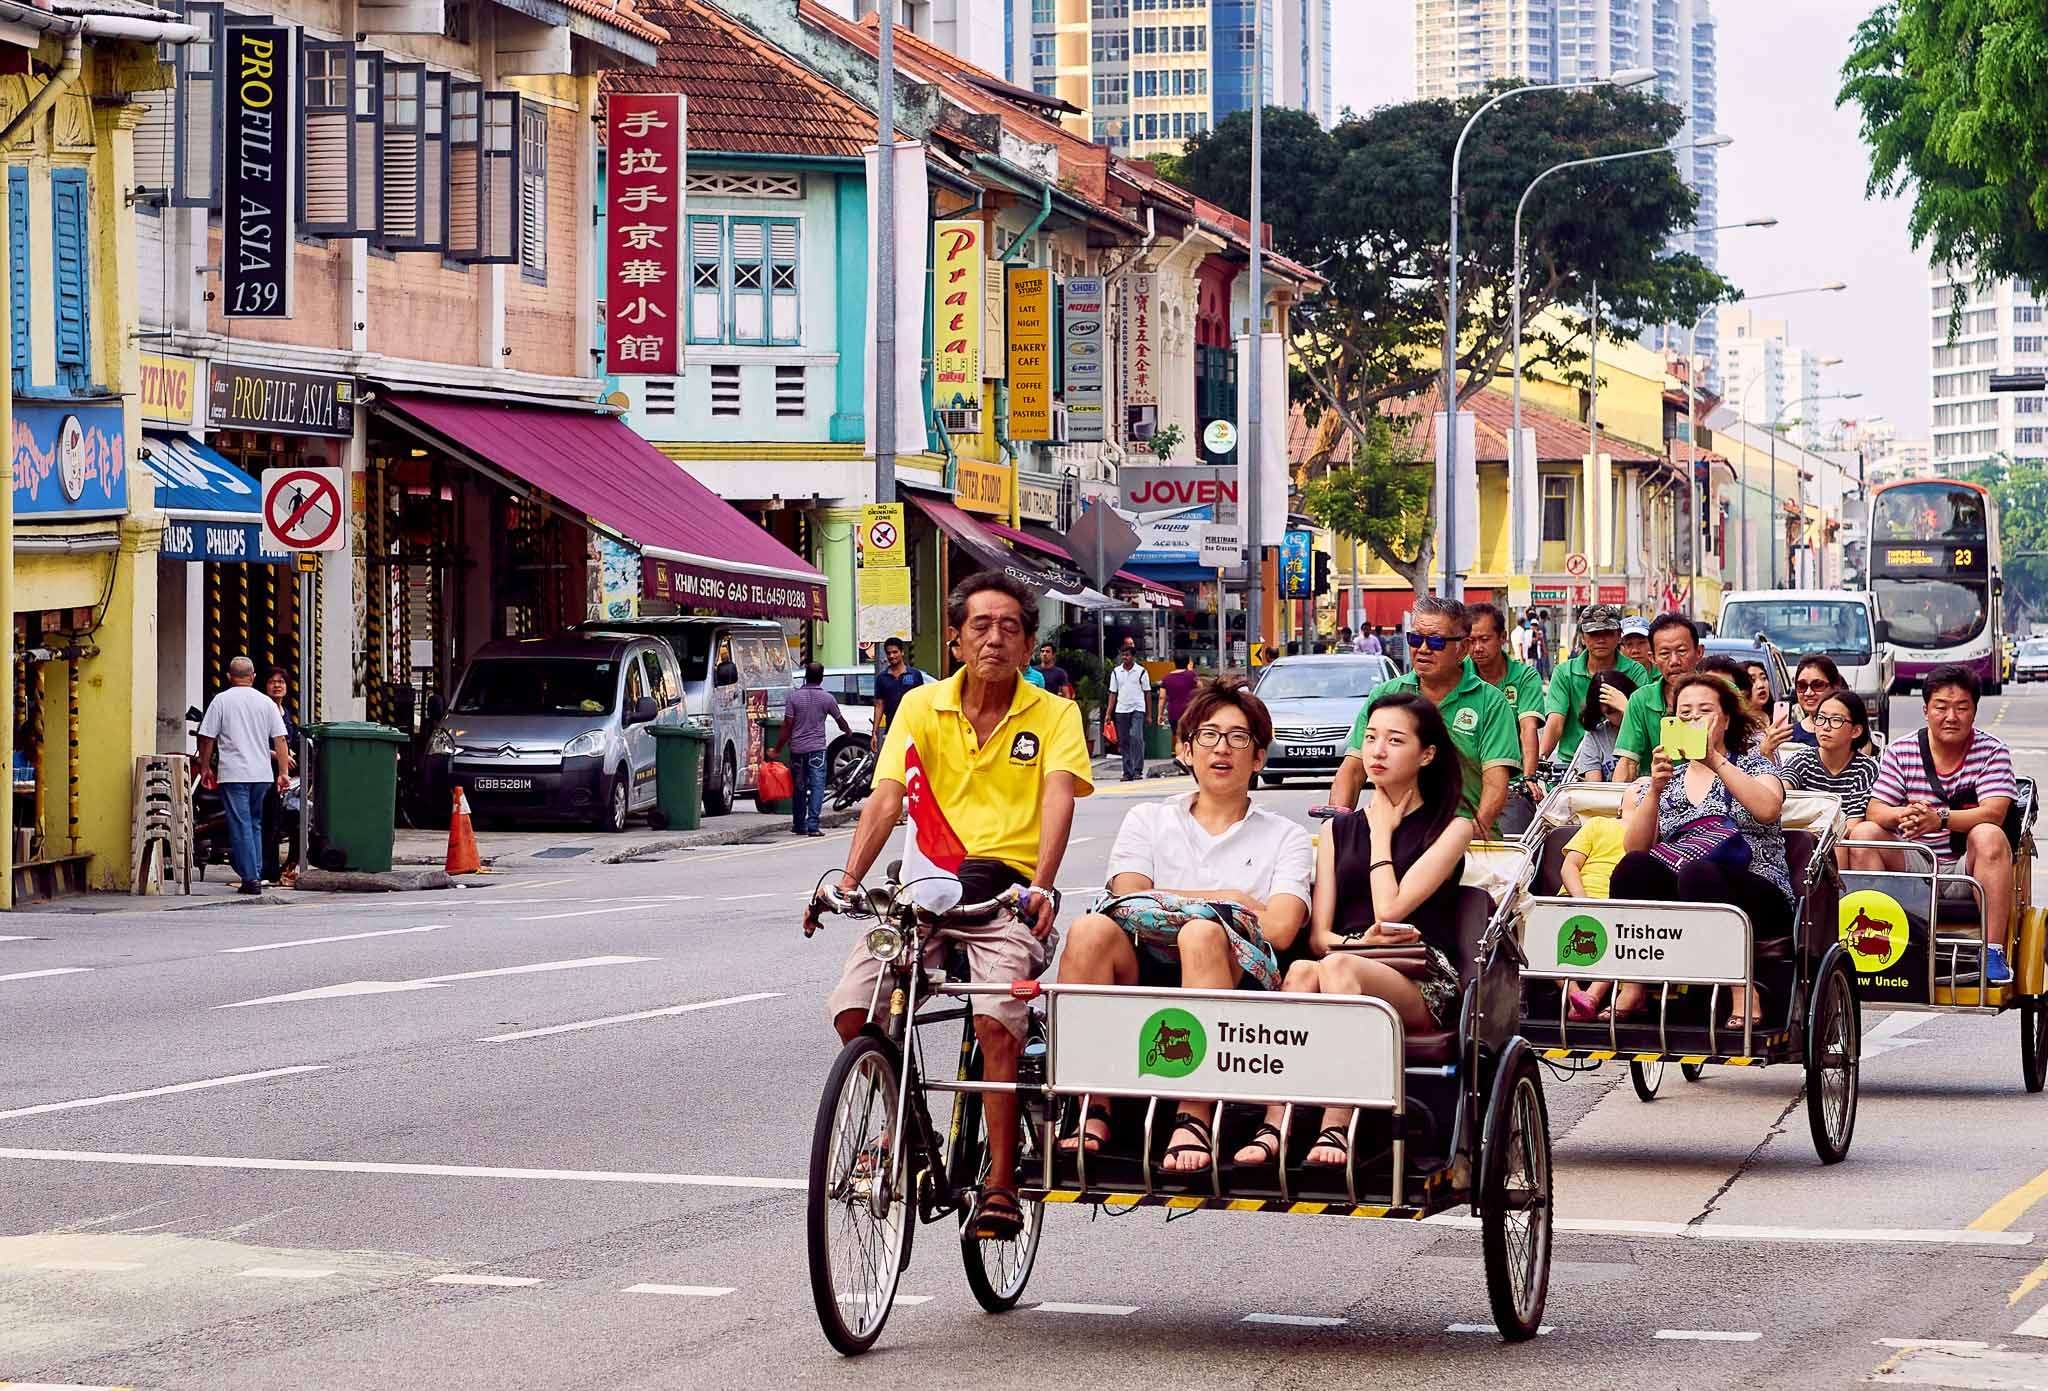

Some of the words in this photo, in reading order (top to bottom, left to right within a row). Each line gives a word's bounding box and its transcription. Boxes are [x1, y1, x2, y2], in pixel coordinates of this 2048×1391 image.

[240, 34, 273, 181] PROFILE
[240, 195, 272, 273] ASIA
[616, 110, 668, 362] 手拉手京華小館
[939, 228, 976, 353] Prata
[1015, 280, 1043, 289] BUTTER
[1018, 287, 1041, 295] STUDIO
[233, 282, 278, 312] 139
[1011, 344, 1046, 352] BAKERY
[1018, 357, 1040, 366] CAFE
[1016, 382, 1042, 390] COFFEE
[231, 376, 297, 424] PROFILE
[299, 384, 333, 426] ASIA
[981, 472, 1001, 504] STUDIO
[1129, 480, 1238, 503] JOVEN
[1153, 524, 1189, 532] NOLAN
[206, 527, 246, 556] PHILIPS
[1955, 549, 1972, 565] 23
[674, 573, 697, 595] KHIM
[700, 578, 724, 599] SENG
[728, 583, 748, 602] GAS
[787, 589, 805, 608] 0288
[1288, 747, 1333, 756] SJV3914J
[1616, 924, 1683, 939] Trishaw
[1615, 945, 1665, 960] Uncle
[1875, 976, 1909, 987] Uncle
[1218, 1022, 1309, 1046] Trishaw
[1217, 1052, 1284, 1074] Uncle
